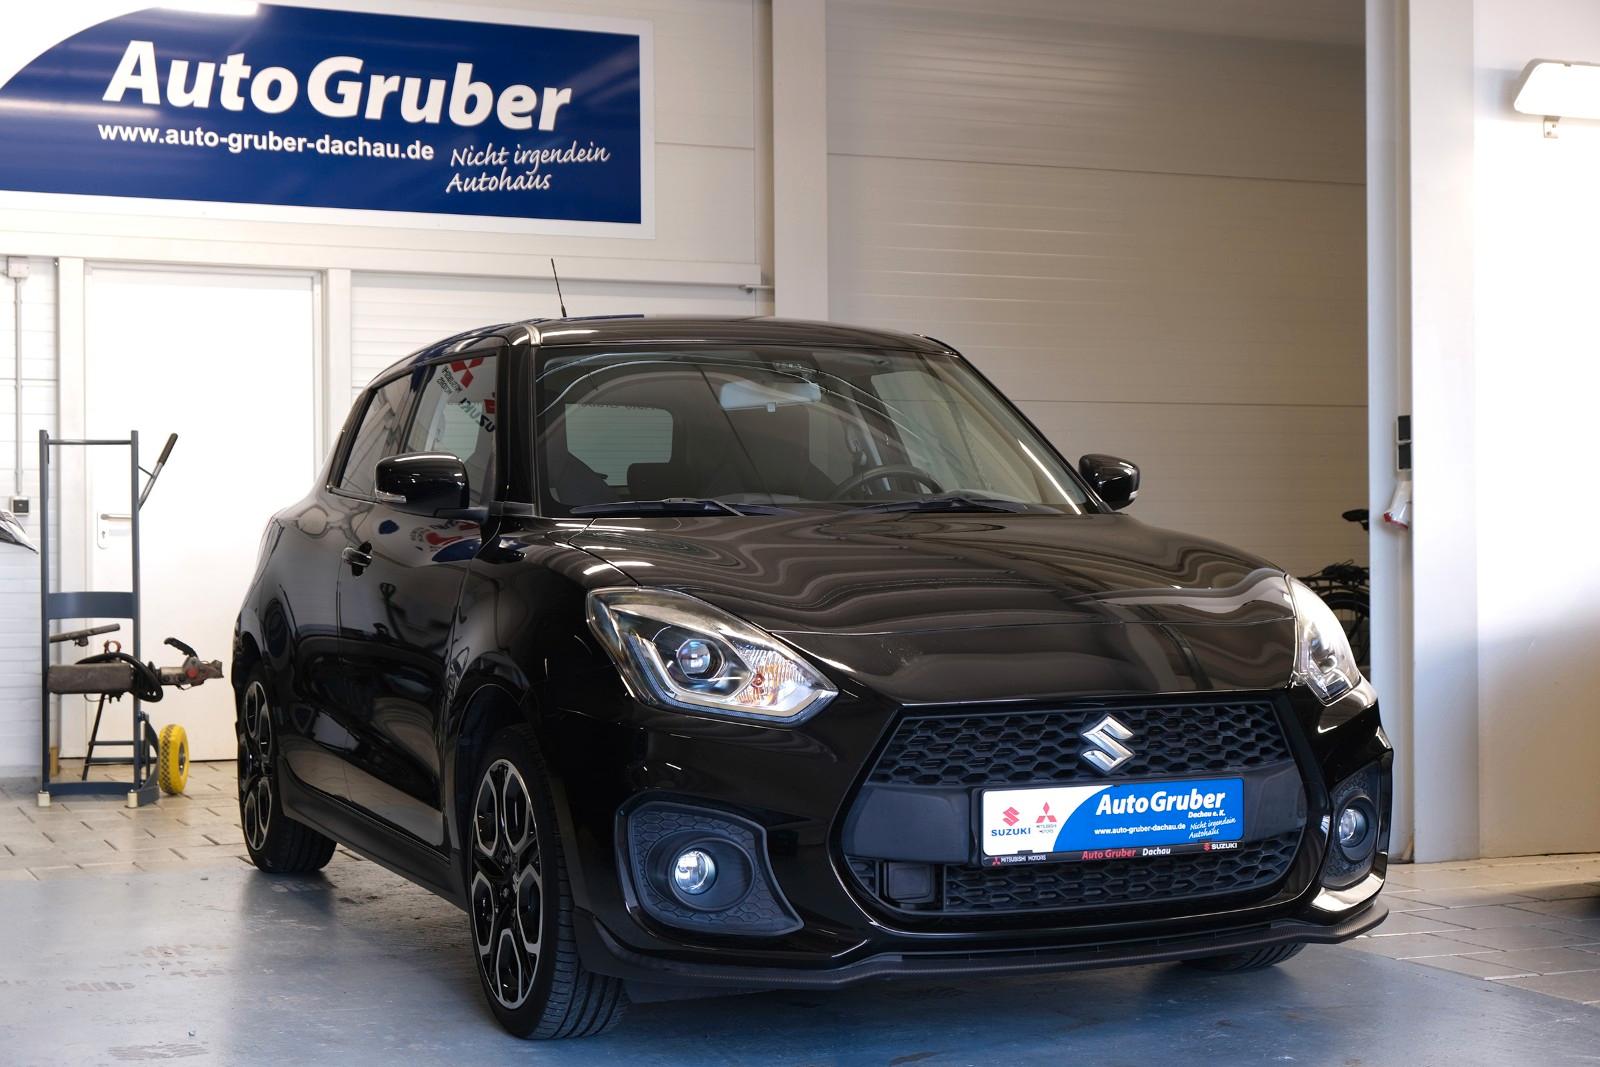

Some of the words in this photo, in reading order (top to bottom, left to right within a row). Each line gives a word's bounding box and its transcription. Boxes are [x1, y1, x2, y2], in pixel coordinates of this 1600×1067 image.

[98, 123, 435, 162] www.auto-gruber-dachau.de
[450, 145, 509, 167] Nicht
[511, 140, 611, 175] irgendein
[445, 168, 552, 194] Autohaus
[1094, 822, 1186, 836] www.auto-gruber-dachau.de
[1190, 820, 1208, 830] Nicht
[1209, 816, 1237, 830] irgendein
[991, 828, 1032, 837] SUZUKI
[1142, 847, 1171, 857] Dachau
[1211, 842, 1238, 850] SUZUKI
[1082, 851, 1103, 861] Auto
[1104, 849, 1137, 859] Gruber
